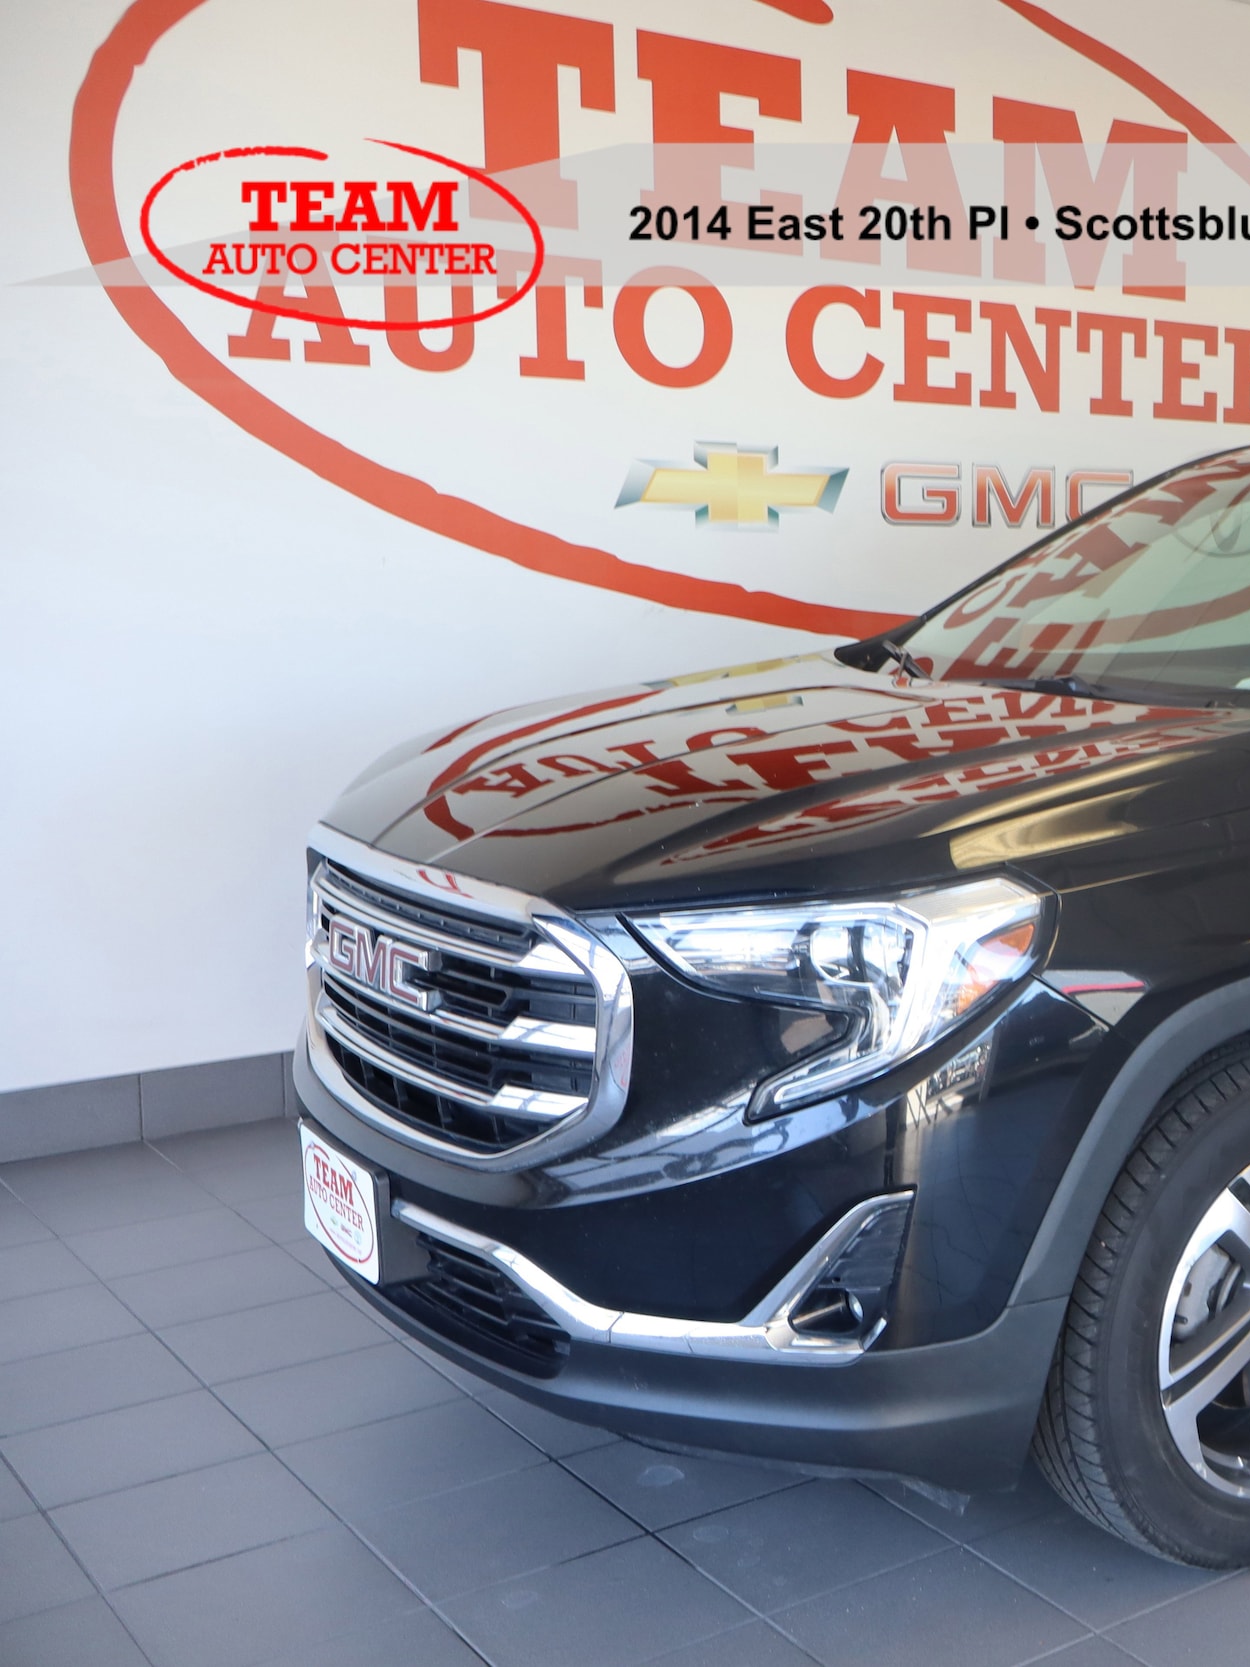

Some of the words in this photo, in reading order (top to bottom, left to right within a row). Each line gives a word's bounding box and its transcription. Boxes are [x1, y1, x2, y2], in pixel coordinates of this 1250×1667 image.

[416, 0, 1189, 303] TEAM
[227, 222, 733, 390] AUTO
[328, 914, 436, 1011] GMC
[309, 1175, 328, 1202] AUTO
[329, 1193, 364, 1232] CENTER
[313, 1153, 354, 1207] TEAM
